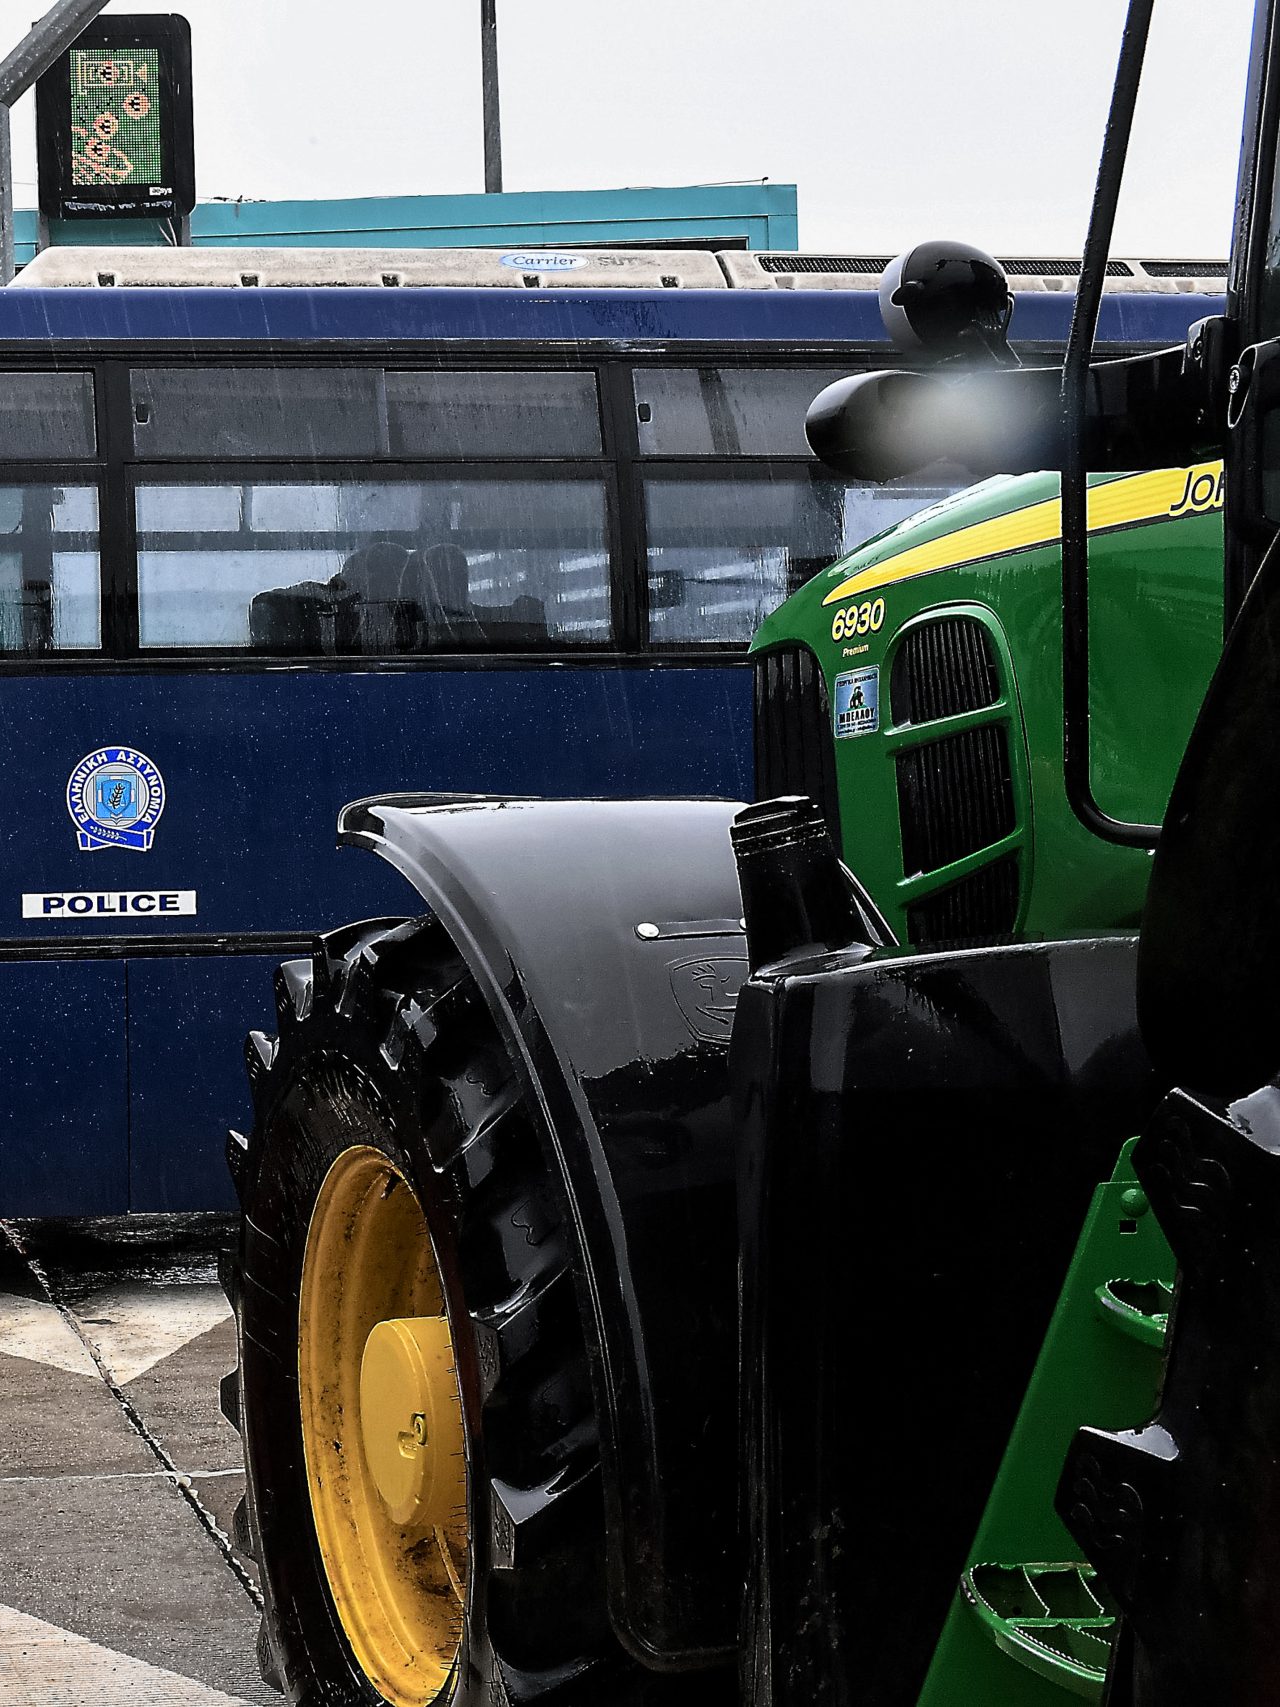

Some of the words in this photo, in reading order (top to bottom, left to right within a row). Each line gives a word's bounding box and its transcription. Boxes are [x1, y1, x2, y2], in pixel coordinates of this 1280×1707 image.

[513, 256, 577, 266] Carrier
[832, 597, 885, 641] 6930
[842, 644, 869, 658] Premium
[71, 751, 108, 824] ΕΛΛΗΝΙΚΗ
[116, 750, 161, 824] ΑΣΤΥΝΟΜΙΑ
[42, 894, 180, 914] POLICE
